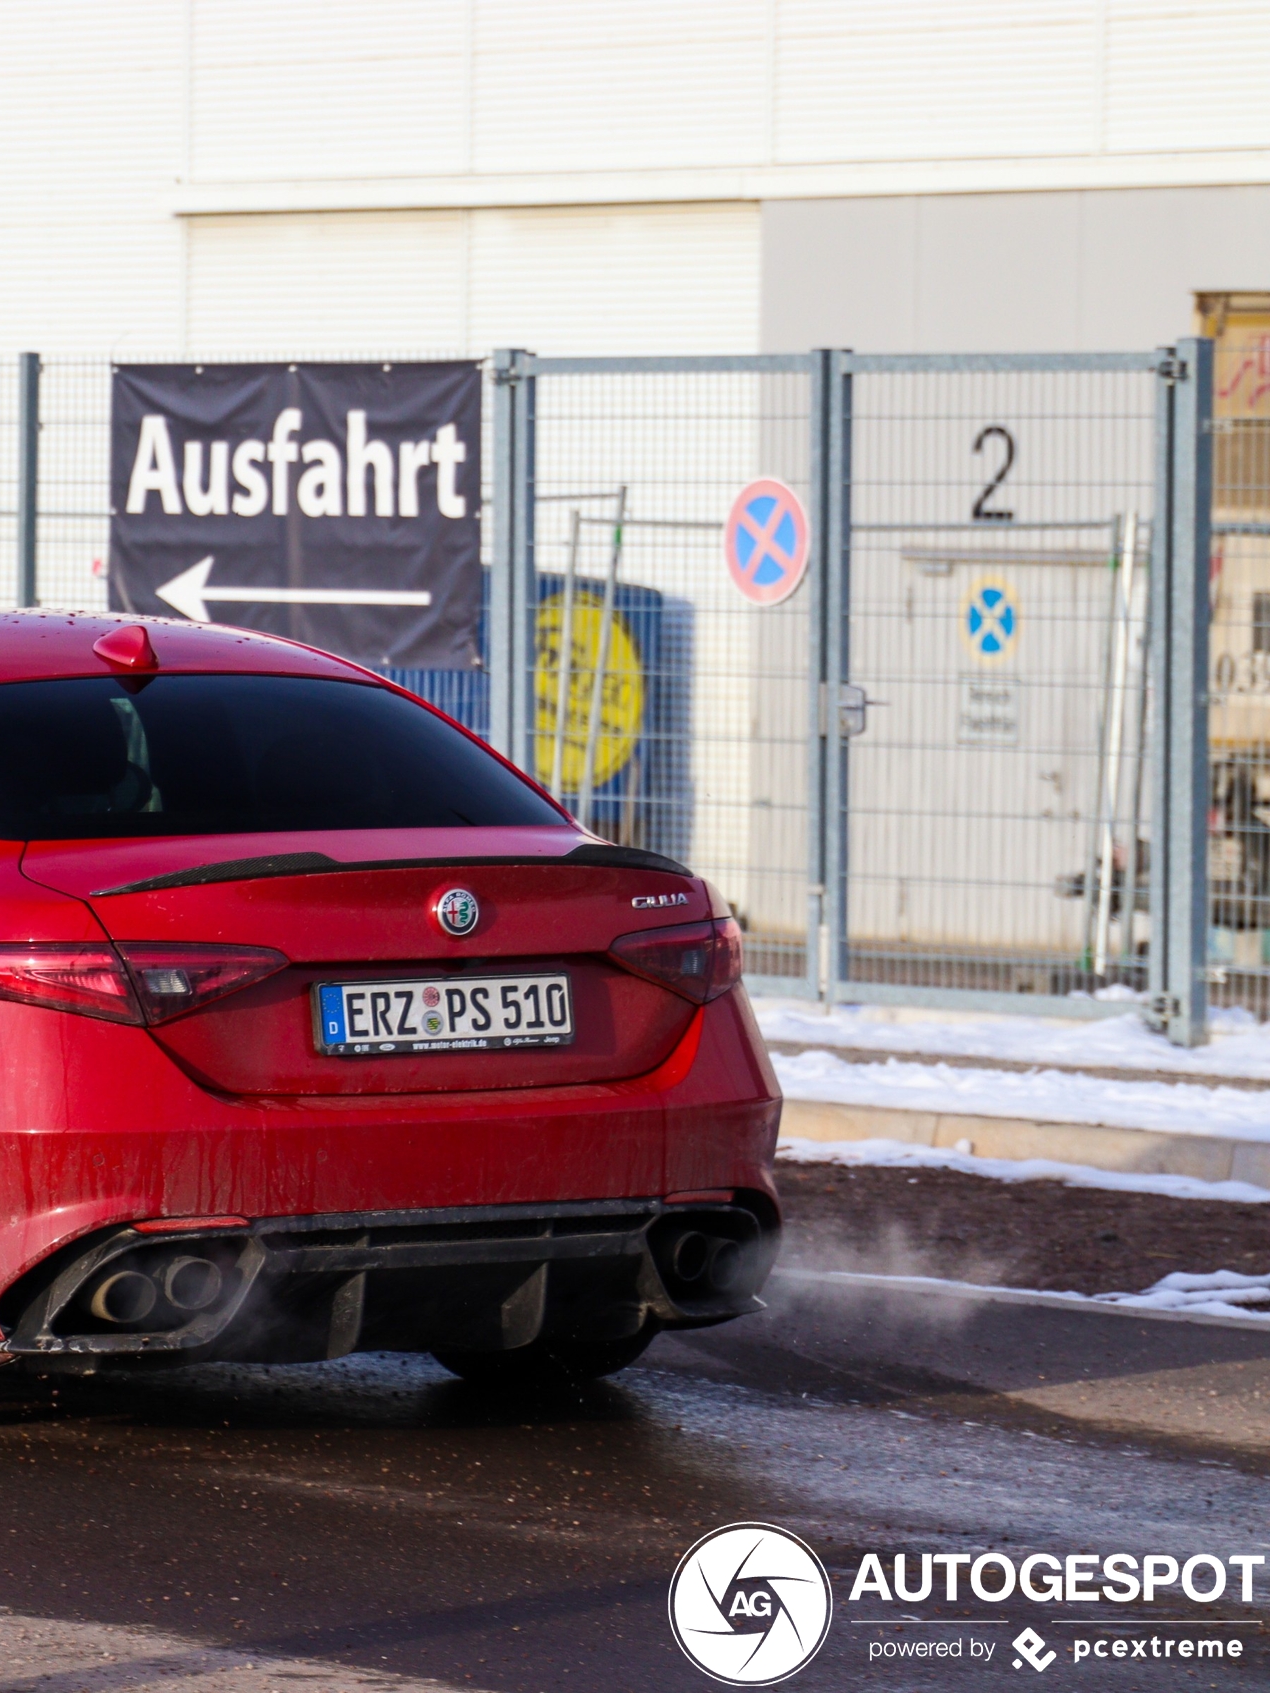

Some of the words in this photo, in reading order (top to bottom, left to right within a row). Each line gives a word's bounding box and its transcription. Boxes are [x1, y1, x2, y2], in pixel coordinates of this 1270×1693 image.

[125, 407, 467, 518] Ausfahrt
[973, 426, 1018, 520] 2
[631, 893, 689, 909] GIULIA
[329, 1021, 338, 1034] D
[346, 991, 417, 1037] ERZ
[445, 987, 492, 1032] PS
[500, 983, 567, 1029] 510
[412, 1039, 487, 1050] www.motor-elektrik.de
